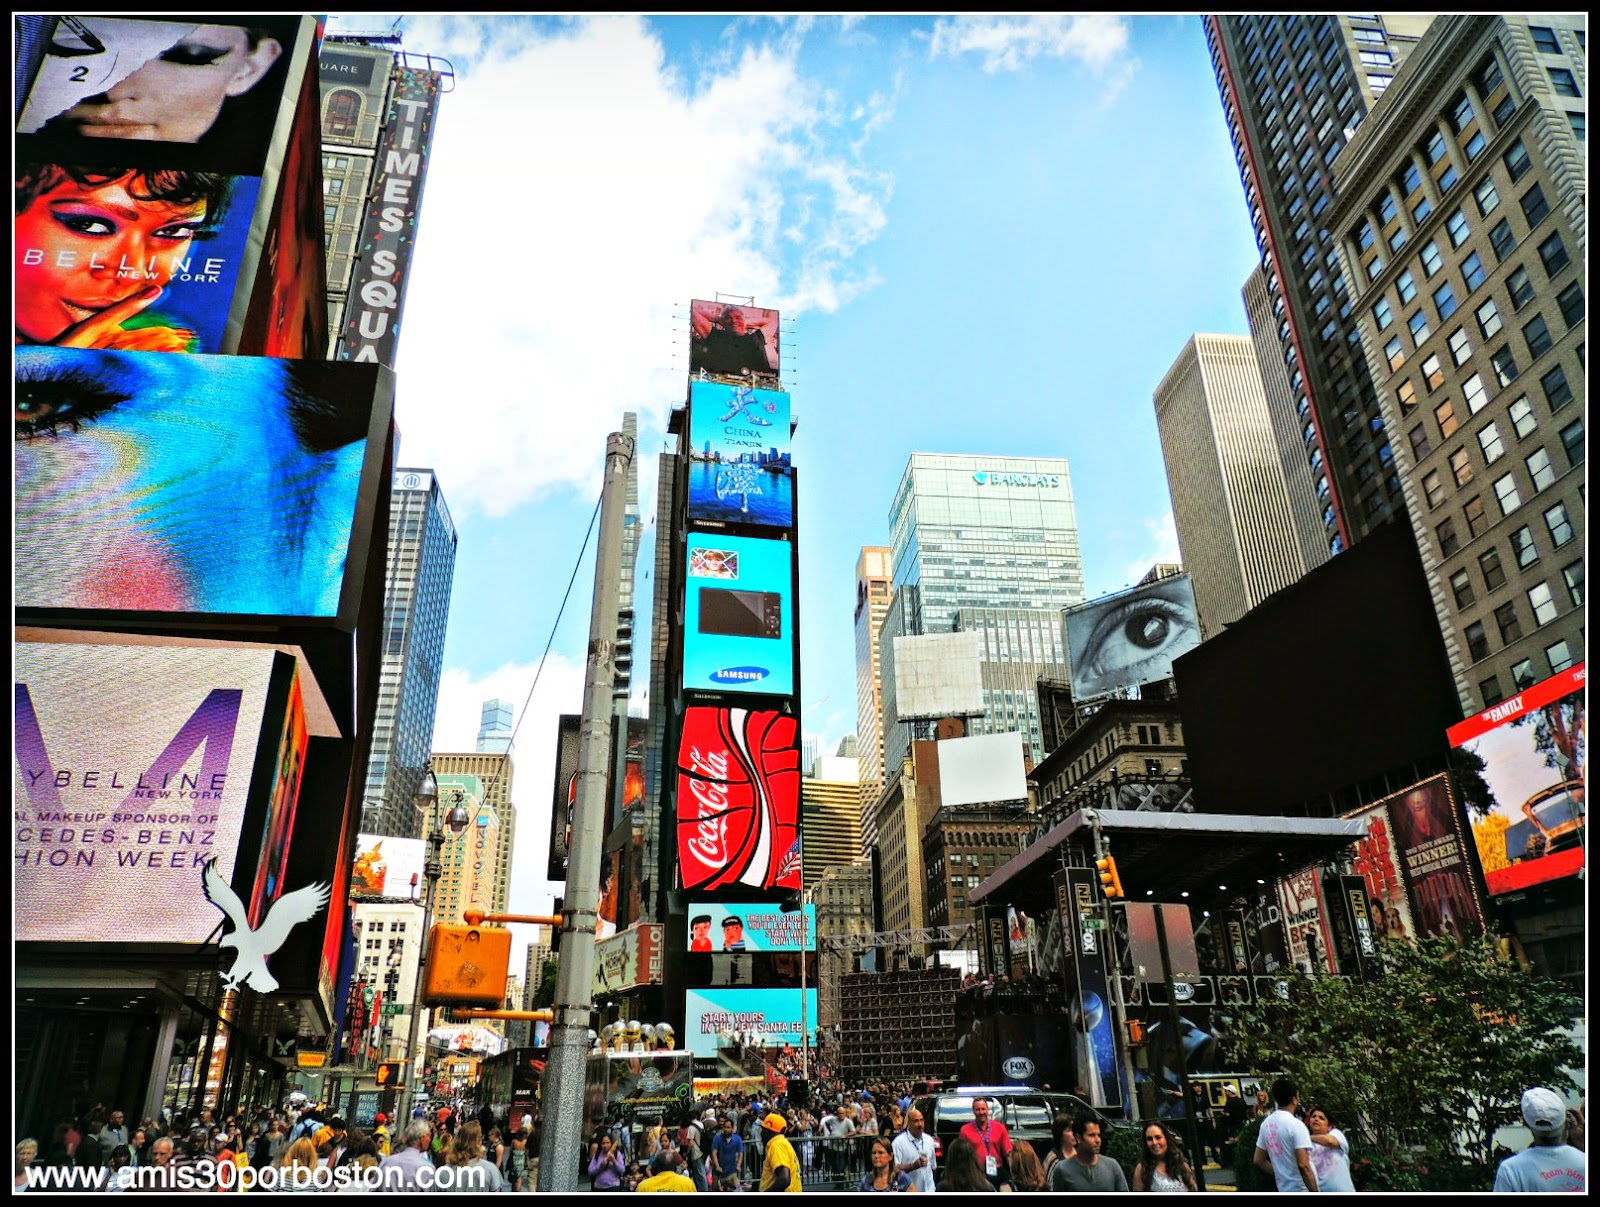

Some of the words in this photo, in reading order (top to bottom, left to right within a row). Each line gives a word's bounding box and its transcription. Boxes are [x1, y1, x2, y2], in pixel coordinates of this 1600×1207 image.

[70, 66, 89, 82] 2
[379, 101, 428, 233] TIMES
[23, 249, 225, 275] BELLINE
[117, 271, 159, 281] NEW
[169, 272, 219, 283] YORK
[724, 426, 762, 438] CHINA
[724, 437, 762, 448] TIANJIN
[991, 472, 1059, 488] BARCLAYS
[717, 670, 763, 680] SAMSUNG
[1490, 696, 1524, 723] FAMILY
[29, 770, 228, 790] YBELLINE
[135, 790, 171, 799] NEW
[178, 790, 222, 800] YORK
[688, 745, 729, 868] Coca-Cola
[37, 812, 106, 823] MAKEUP
[112, 813, 189, 824] SPONSOR
[197, 814, 218, 824] OF
[17, 827, 216, 845] CEDES-BENZ
[117, 851, 211, 869] WEEK
[1406, 841, 1459, 868] WINNER!
[471, 829, 485, 903] NOVOTEL
[746, 914, 759, 922] THE
[761, 914, 778, 922] BEST
[1353, 893, 1365, 916] NFL
[1361, 931, 1374, 955] FOX
[773, 921, 792, 930] EVER
[794, 921, 810, 930] TEL
[765, 930, 787, 938] START
[701, 1012, 731, 1023] START
[734, 1012, 764, 1023] YOURS
[701, 1023, 711, 1034] IN
[715, 1022, 732, 1033] THE
[758, 1022, 788, 1033] SANTA
[1010, 1061, 1027, 1070] FOX
